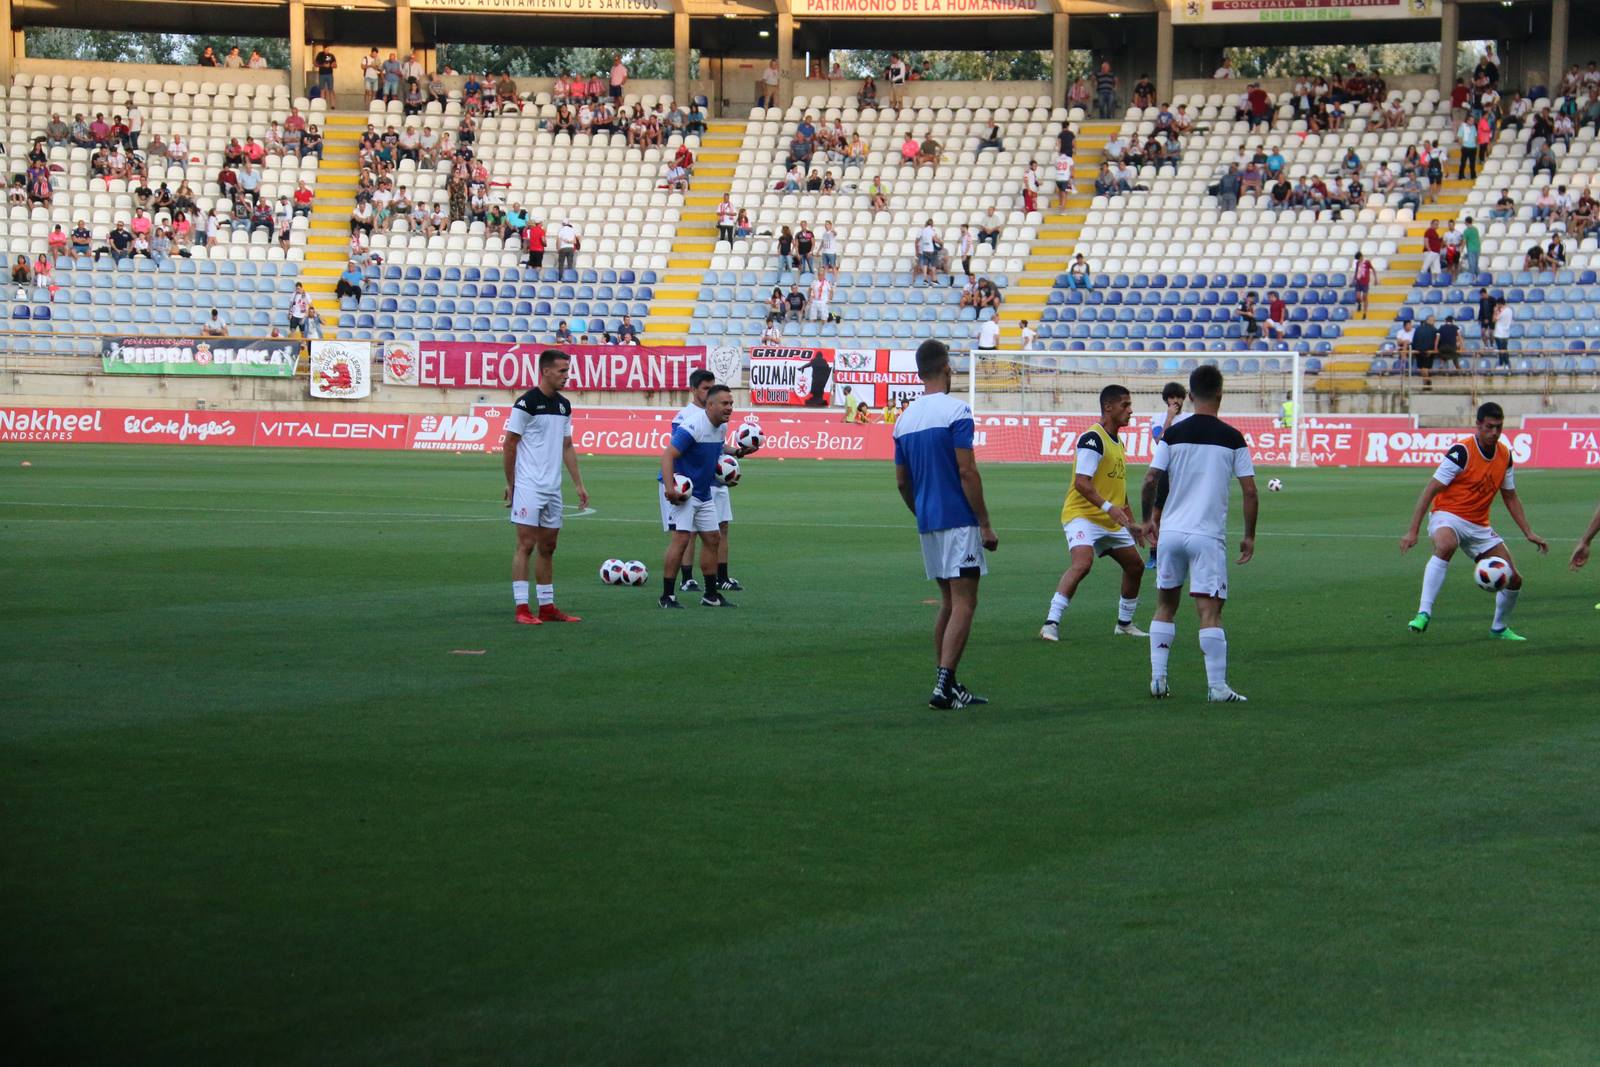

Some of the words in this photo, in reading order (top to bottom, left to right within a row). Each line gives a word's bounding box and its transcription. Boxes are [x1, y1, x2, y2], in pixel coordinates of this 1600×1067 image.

[579, 0, 592, 9] DE
[807, 0, 897, 11] PATRIMONIO
[903, 0, 918, 11] DE
[925, 0, 941, 11] LA
[947, 0, 1037, 10] HUMANIDAD
[122, 346, 193, 364] PIEDRA
[213, 348, 284, 365] BLANCA
[322, 350, 349, 371] CULTURAL
[752, 348, 814, 359] GRUPO
[419, 349, 455, 385] EL
[464, 344, 540, 387] LEÓN
[565, 353, 702, 389] AMPANTE
[751, 361, 796, 385] GUZMÁN
[836, 371, 924, 384] CULTURALISTA
[0, 409, 102, 431] Nakheel
[124, 415, 140, 433] El
[141, 416, 179, 434] Corte
[179, 412, 235, 440] Inglés
[0, 431, 73, 440] ANDSCAPES
[261, 421, 404, 439] VITALDENT
[724, 430, 864, 450] Mcedes-Benz
